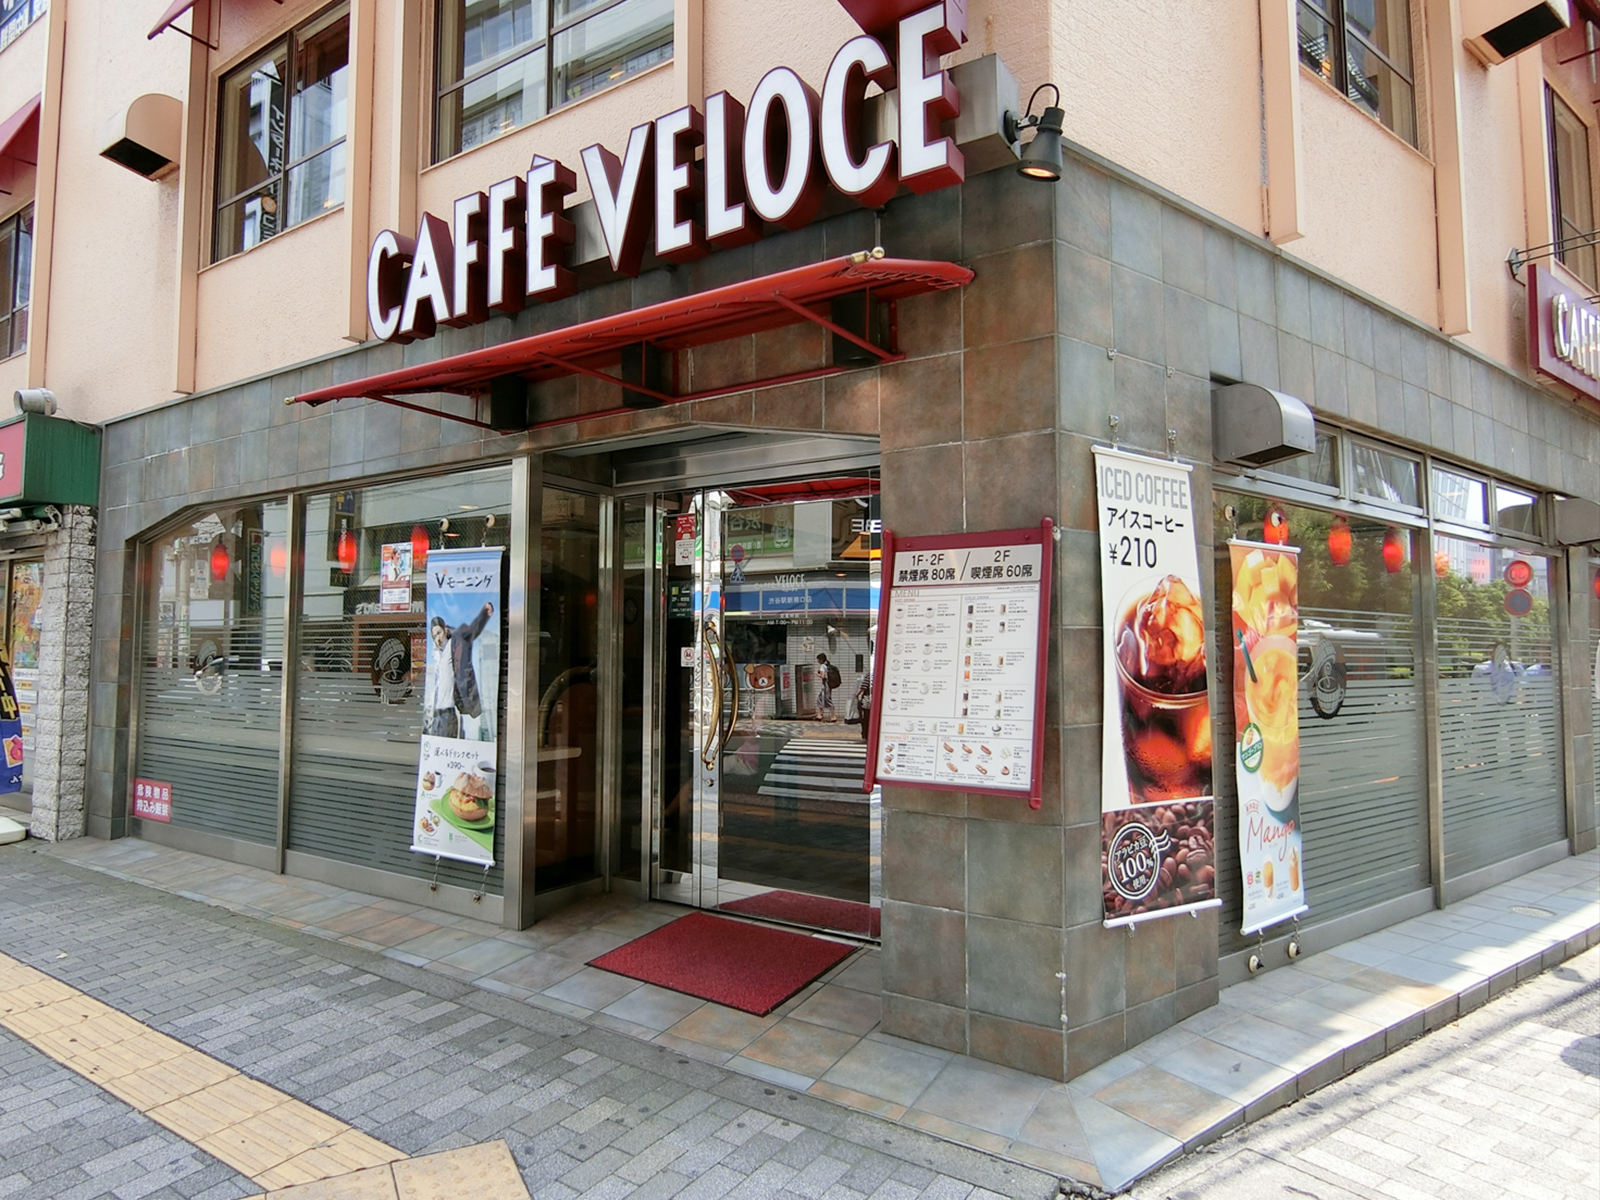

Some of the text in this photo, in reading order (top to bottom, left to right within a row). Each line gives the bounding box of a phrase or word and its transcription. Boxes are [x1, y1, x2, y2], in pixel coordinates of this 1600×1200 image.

[580, 2, 958, 275] VELOCE
[1099, 465, 1188, 510] ICED COFFEE
[1106, 507, 1184, 533] アイスコーヒー
[994, 550, 1011, 563] 2F
[1108, 535, 1157, 568] ¥210
[774, 573, 805, 588] VELOCE
[898, 567, 956, 583] 禁煙席 80席
[1006, 564, 1033, 578] 60席
[895, 589, 920, 597] MENU
[1246, 816, 1296, 862] Mango
[1117, 852, 1154, 884] 100%
